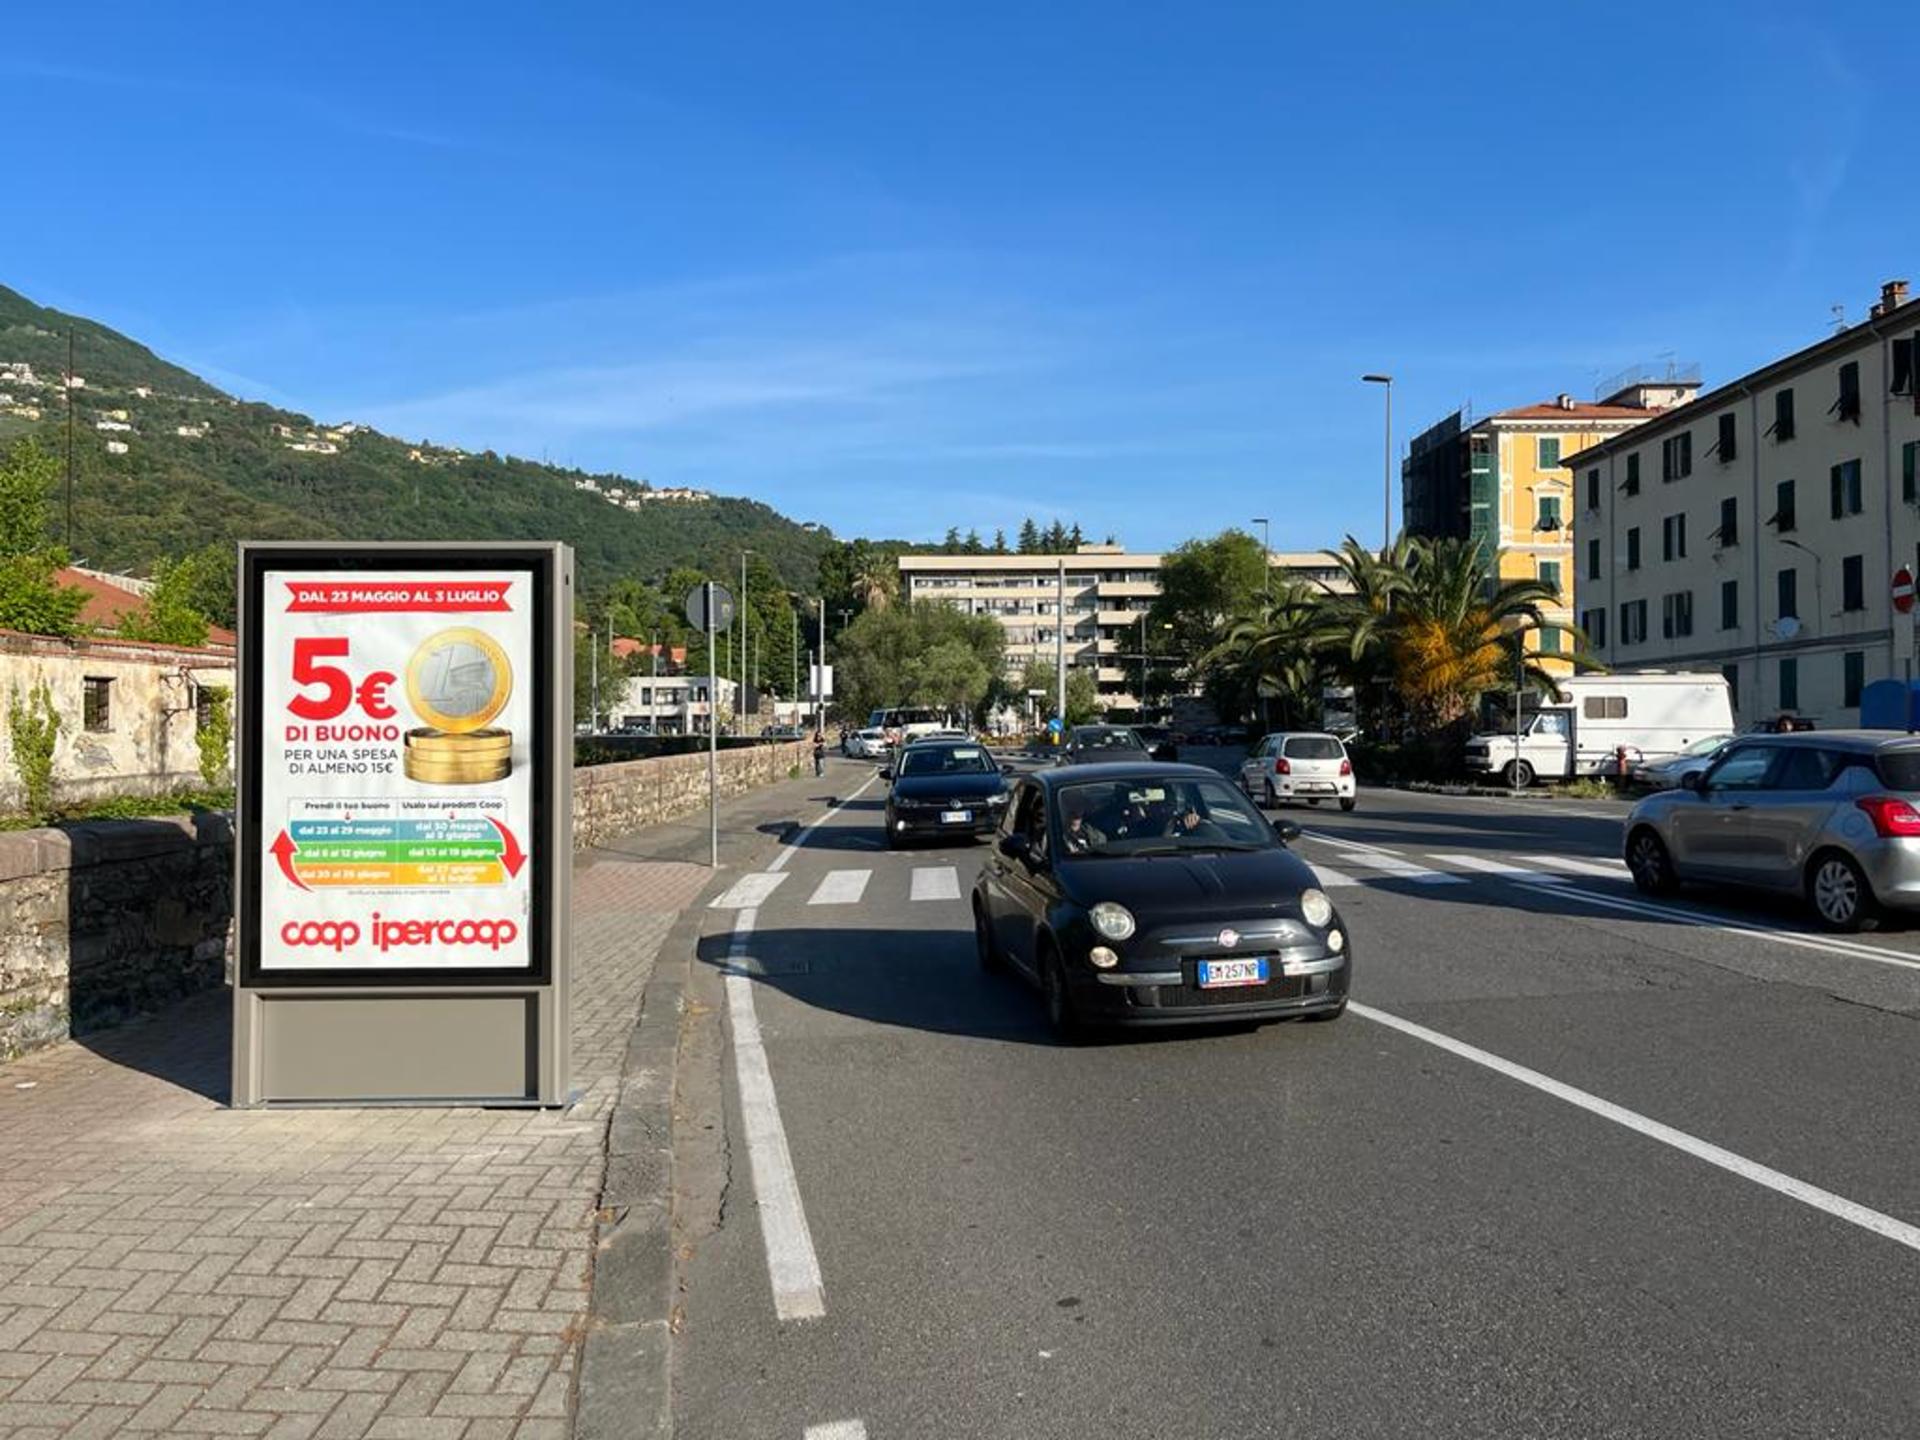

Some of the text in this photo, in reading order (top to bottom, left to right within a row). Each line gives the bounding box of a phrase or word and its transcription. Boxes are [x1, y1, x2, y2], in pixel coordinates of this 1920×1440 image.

[299, 590, 500, 603] DAL 23 MAGGIO AL 3 LUGLIO
[286, 725, 400, 742] DI BUONO
[284, 749, 399, 761] PER UNA SPESA
[289, 763, 394, 774] DI ALMENO 15€
[305, 802, 334, 810] Prendi
[361, 802, 391, 810] buono
[442, 801, 477, 811] prodotti
[480, 801, 504, 811] Coop
[281, 912, 518, 952] coop ipercoop
